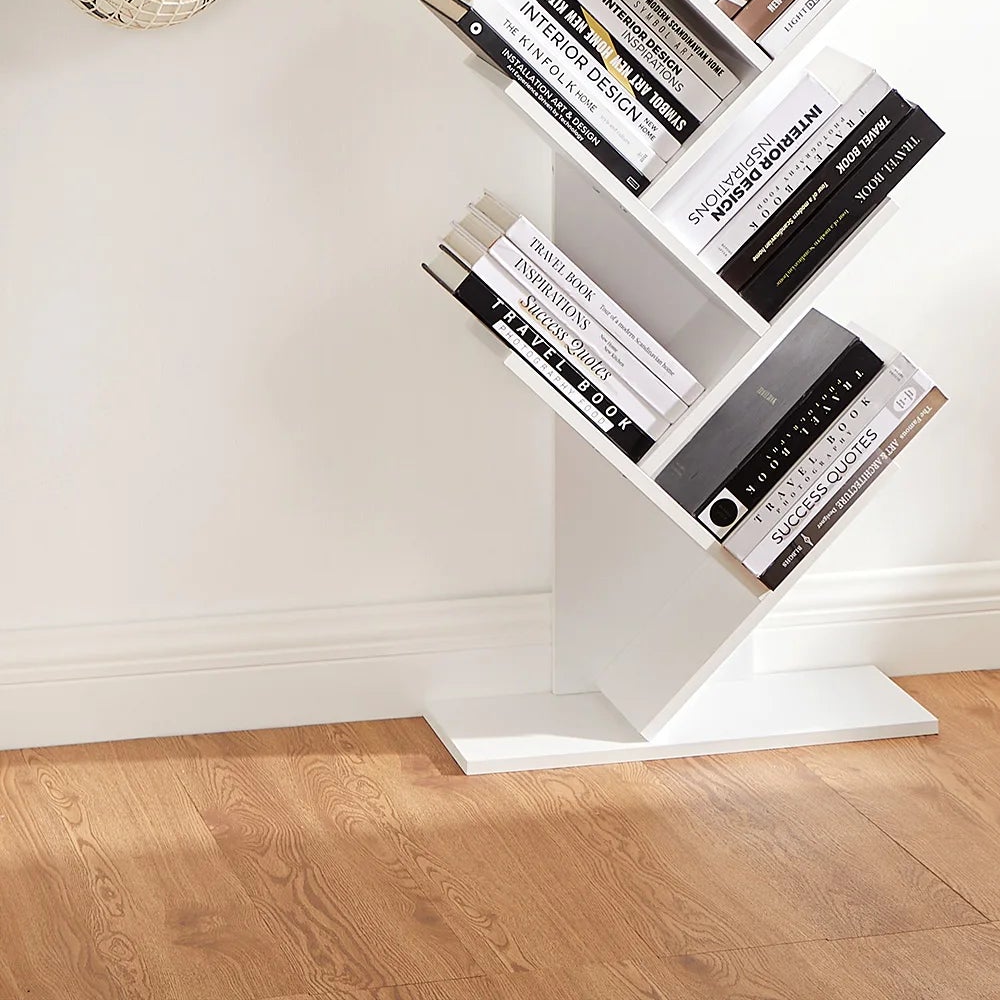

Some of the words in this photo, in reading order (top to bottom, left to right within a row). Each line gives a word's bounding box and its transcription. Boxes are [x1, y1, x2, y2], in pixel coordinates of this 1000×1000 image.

[562, 7, 589, 34] NEW
[581, 26, 615, 59] HOME
[631, 0, 672, 40] SYMBOL
[672, 40, 694, 62] ART
[782, 5, 809, 33] LIGHT
[500, 17, 520, 37] THE
[516, 33, 579, 94] KINFOLK
[573, 89, 598, 114] HOME
[517, 0, 591, 71] INTERIOR
[584, 65, 644, 123] DESIGN
[608, 53, 634, 79] NEW
[619, 28, 686, 93] INSPIRATIONS
[643, 37, 684, 76] DESIGN
[666, 18, 710, 61] SCANDINAVIAN
[704, 57, 725, 77] HOME
[499, 46, 554, 101] INSTALLATION
[627, 71, 653, 97] ART
[504, 63, 517, 76] Art
[512, 71, 540, 99] Experience
[535, 93, 554, 111] Driven
[549, 107, 561, 119] by
[555, 113, 586, 143] Technology
[548, 95, 569, 115] ART
[563, 109, 576, 122] &
[642, 116, 659, 133] NEW
[645, 90, 688, 132] SYMBOL
[569, 116, 602, 148] DESIGN
[636, 122, 657, 142] HOME
[756, 102, 824, 172] INTERIOR
[781, 114, 846, 183] PHOTOGRAPHY
[801, 105, 867, 175] TRAVEL
[856, 113, 892, 150] TRAVEL
[879, 133, 921, 176] TRAVEL
[685, 131, 776, 227] INSPIRATIONS
[832, 144, 862, 175] BOOK
[708, 165, 764, 223] DESIGN
[746, 182, 794, 233] BOOK
[753, 184, 781, 212] FOOD
[790, 199, 811, 221] modern
[815, 180, 829, 194] Tour
[852, 170, 886, 205] BOOK
[750, 245, 767, 263] home
[762, 216, 795, 250] Scandinavian
[525, 235, 569, 277] TRAVEL
[563, 270, 597, 303] BOOK
[512, 256, 592, 332] INSPIRATIONS
[518, 291, 572, 343] Success
[561, 333, 615, 385] Quotes
[597, 303, 613, 318] Tour
[616, 320, 638, 341] modern
[632, 336, 665, 367] Scandinavian
[659, 361, 677, 378] home
[488, 296, 569, 372] TRAVEL
[575, 378, 633, 432] BOOK
[496, 323, 575, 398] PHOTOGRAPHY
[576, 397, 607, 427] FOOD
[763, 377, 843, 463] PHOTOGRAPHY
[797, 366, 864, 438] TRAVEL
[917, 403, 933, 419] The
[882, 437, 901, 457] ART
[897, 414, 922, 441] Famous
[743, 445, 792, 497] BOOK
[752, 453, 819, 525] TRAVEL
[824, 395, 872, 445] BOOK
[774, 428, 854, 514] PHOTOGRAPHY
[877, 450, 889, 462] &
[769, 481, 830, 546] SUCCESS
[823, 426, 880, 487] QUOTES
[832, 455, 885, 510] ARCHITECTURE
[814, 505, 838, 531] Designer
